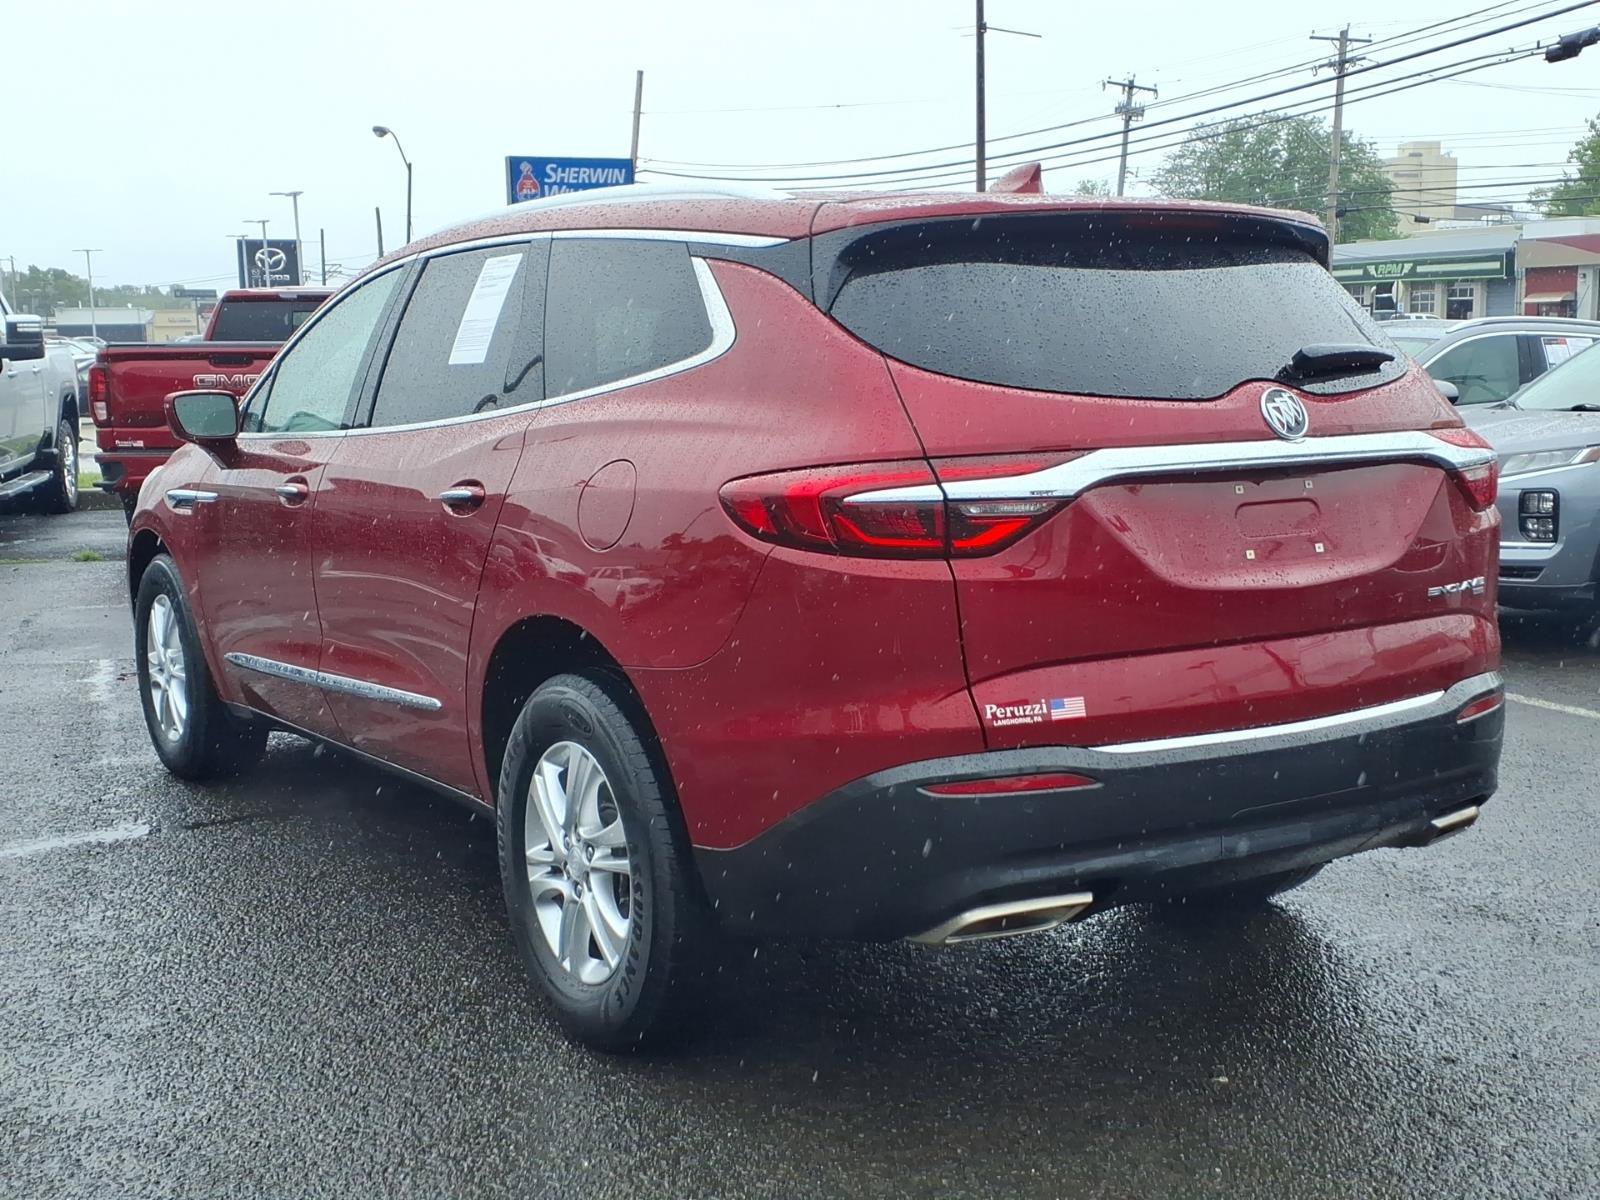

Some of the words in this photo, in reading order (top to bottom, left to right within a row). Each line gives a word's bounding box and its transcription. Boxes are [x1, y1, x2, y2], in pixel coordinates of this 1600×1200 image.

[544, 164, 626, 184] SHERWIN
[1377, 263, 1403, 274] RPM
[1427, 576, 1485, 597] ENCLAVE
[985, 699, 1048, 719] Peruzzi
